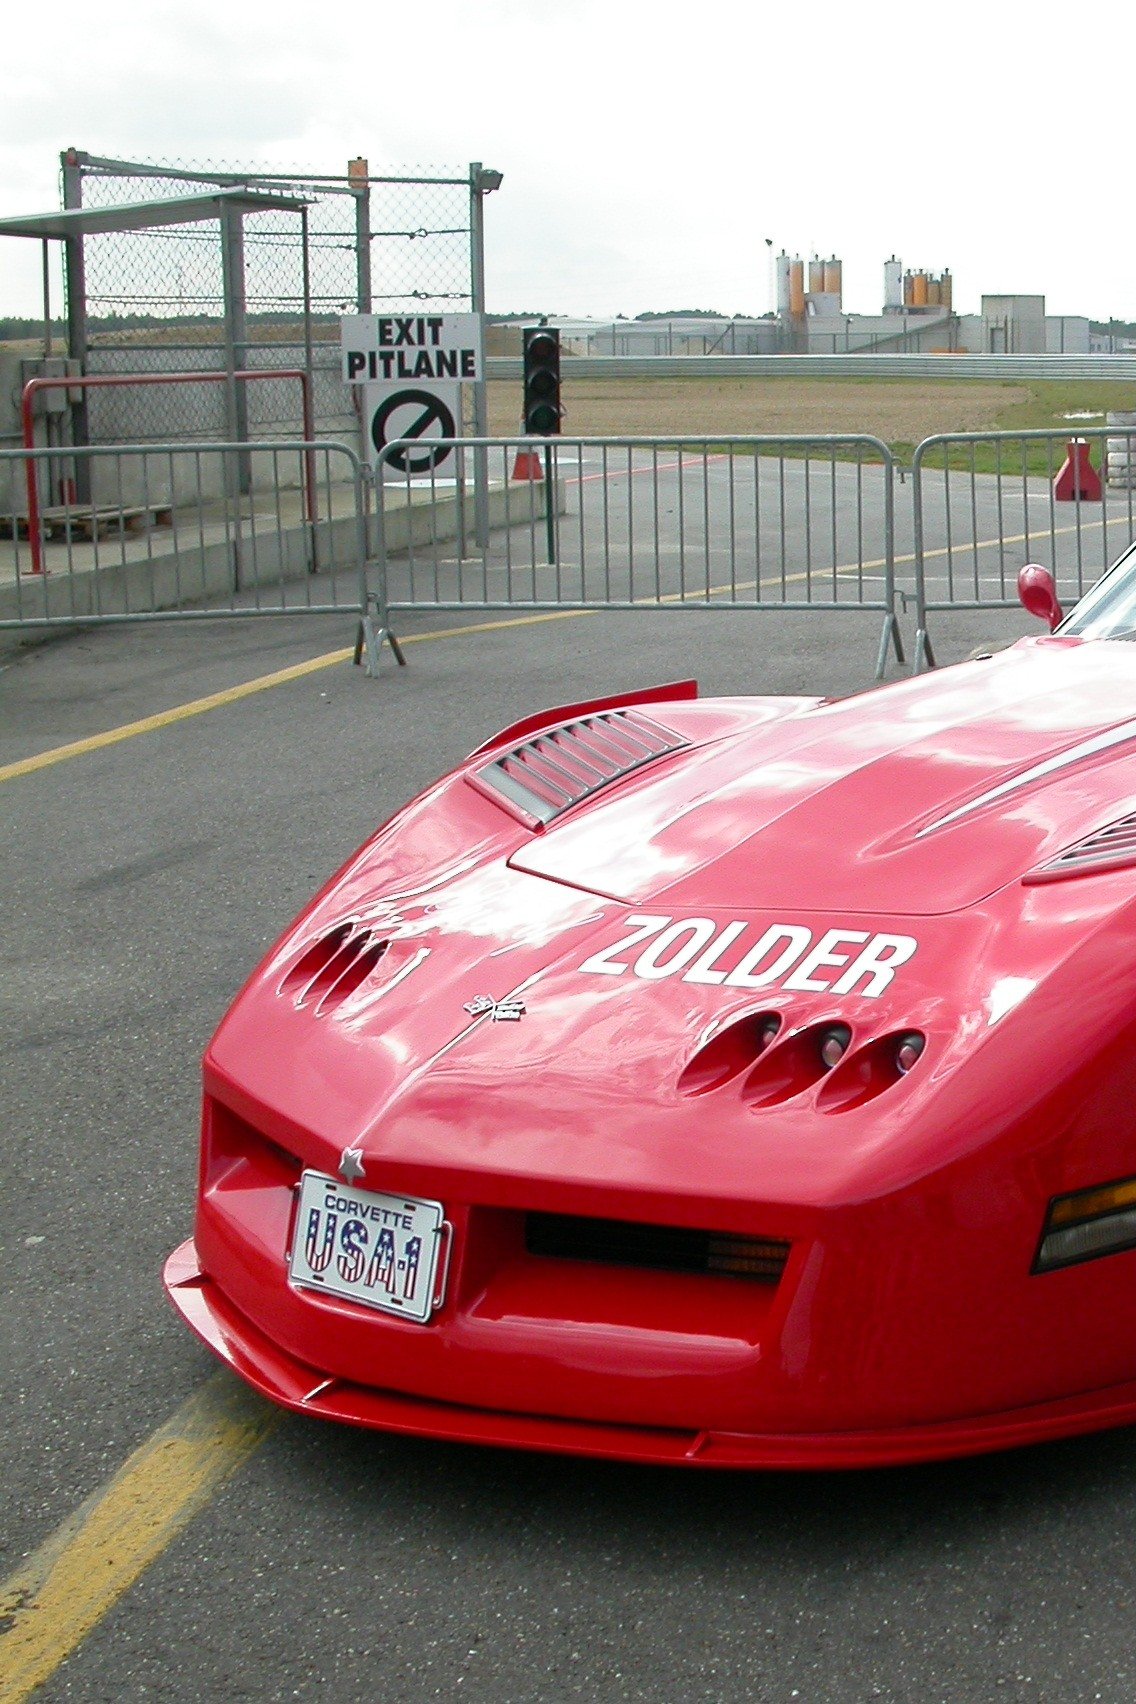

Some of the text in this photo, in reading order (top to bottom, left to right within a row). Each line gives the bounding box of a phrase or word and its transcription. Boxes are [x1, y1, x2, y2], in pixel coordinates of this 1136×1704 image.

[378, 317, 443, 346] EXIT
[347, 349, 476, 379] PITLANE
[577, 914, 918, 998] ZOLDER
[325, 1194, 413, 1231] CORVETTE
